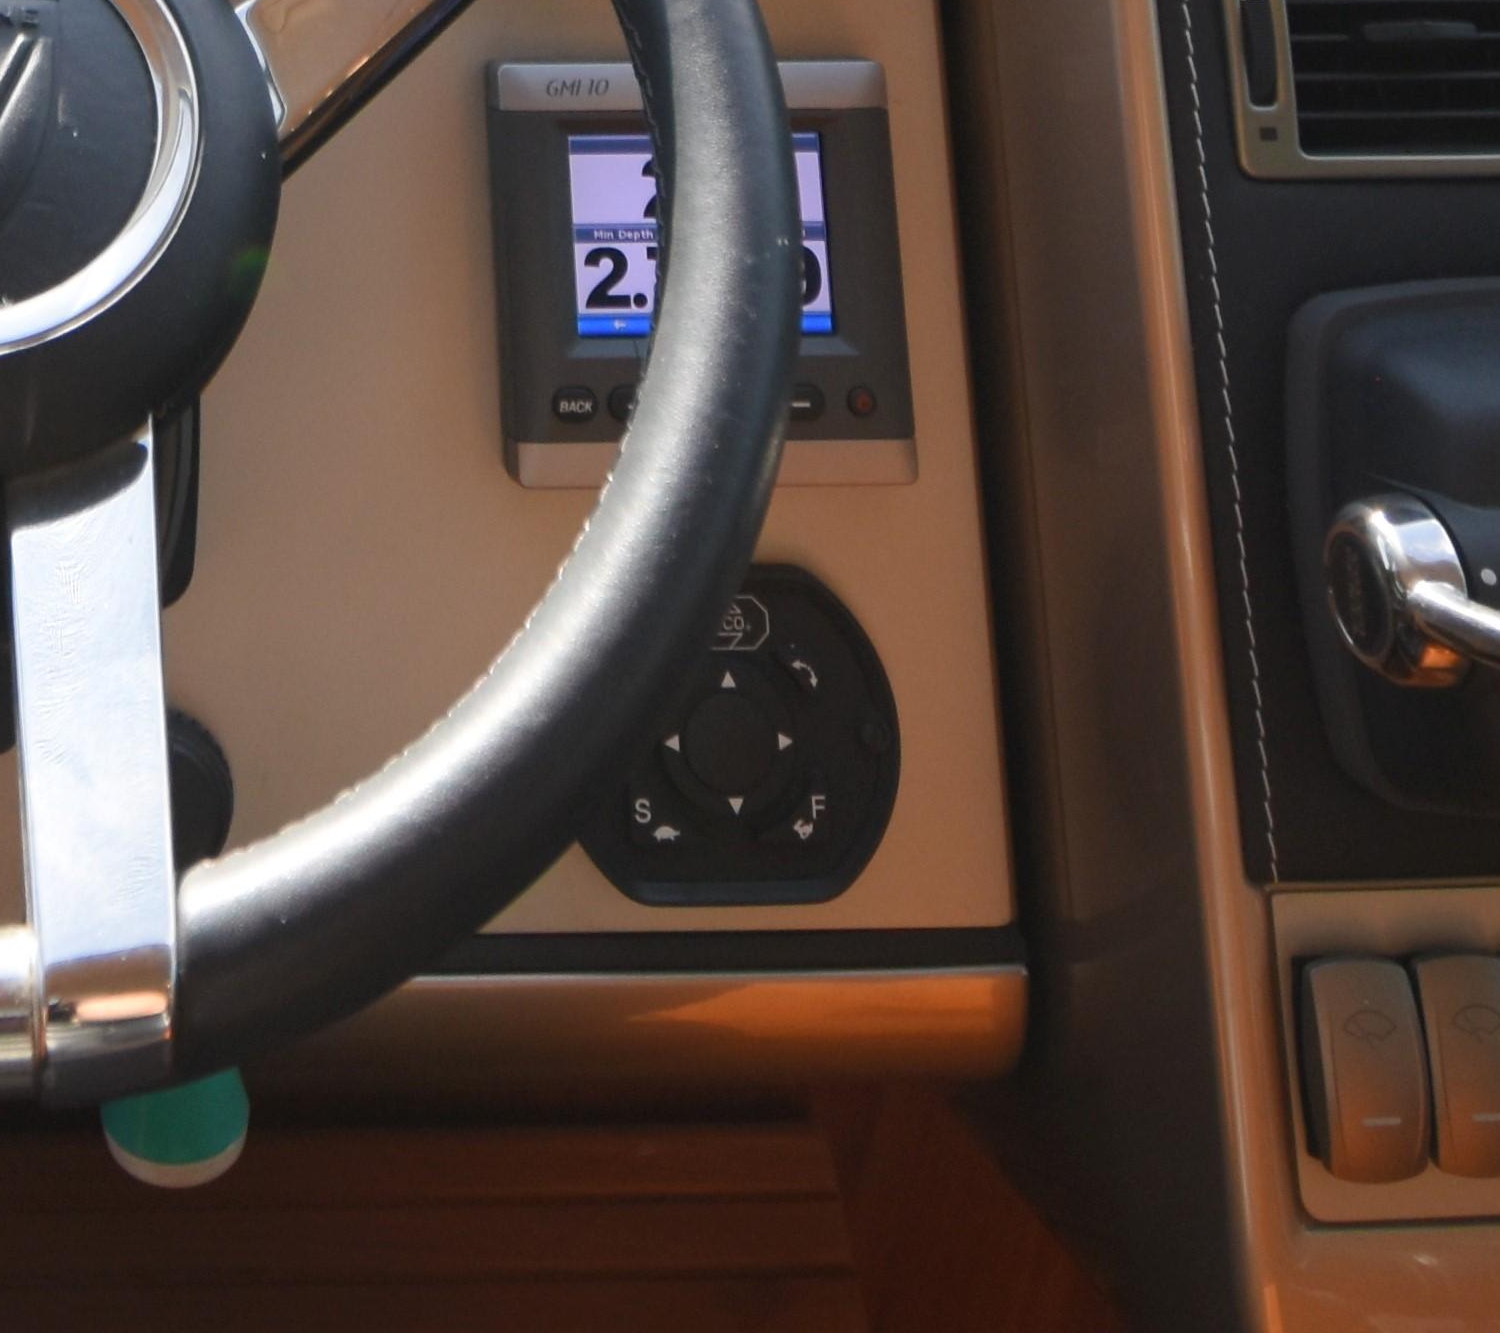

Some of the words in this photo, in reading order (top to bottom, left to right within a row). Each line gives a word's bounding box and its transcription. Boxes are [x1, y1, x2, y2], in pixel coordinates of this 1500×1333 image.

[546, 80, 583, 97] GMI
[593, 230, 615, 240] Min
[618, 229, 655, 242] Depth
[559, 400, 593, 414] BACK
[634, 798, 651, 824] S
[811, 795, 826, 820] F
